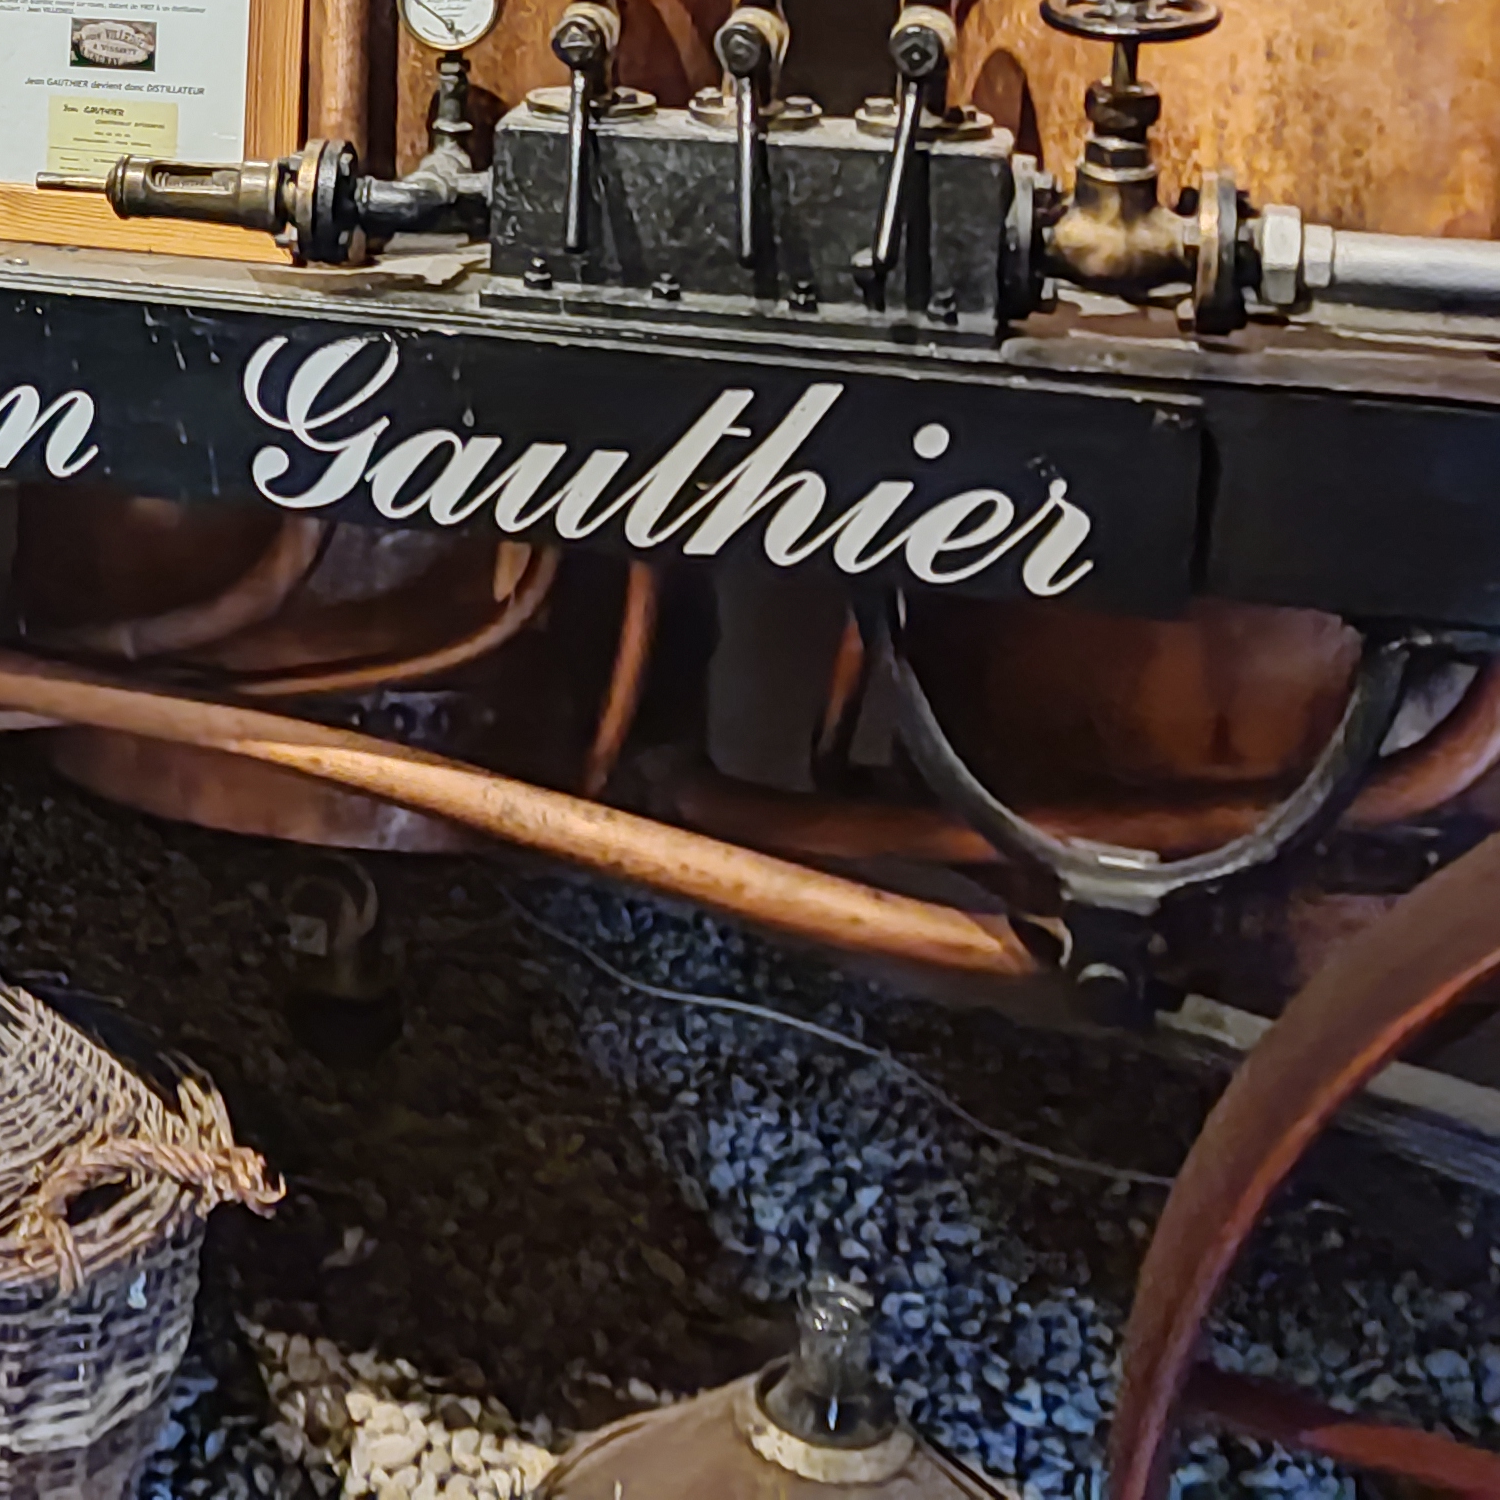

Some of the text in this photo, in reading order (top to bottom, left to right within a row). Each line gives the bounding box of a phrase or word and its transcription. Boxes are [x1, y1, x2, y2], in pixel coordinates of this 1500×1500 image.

[24, 77, 206, 95] Jean GAUTHIER devient donc DISTILLATEUR
[243, 332, 1093, 597] Gauthier
